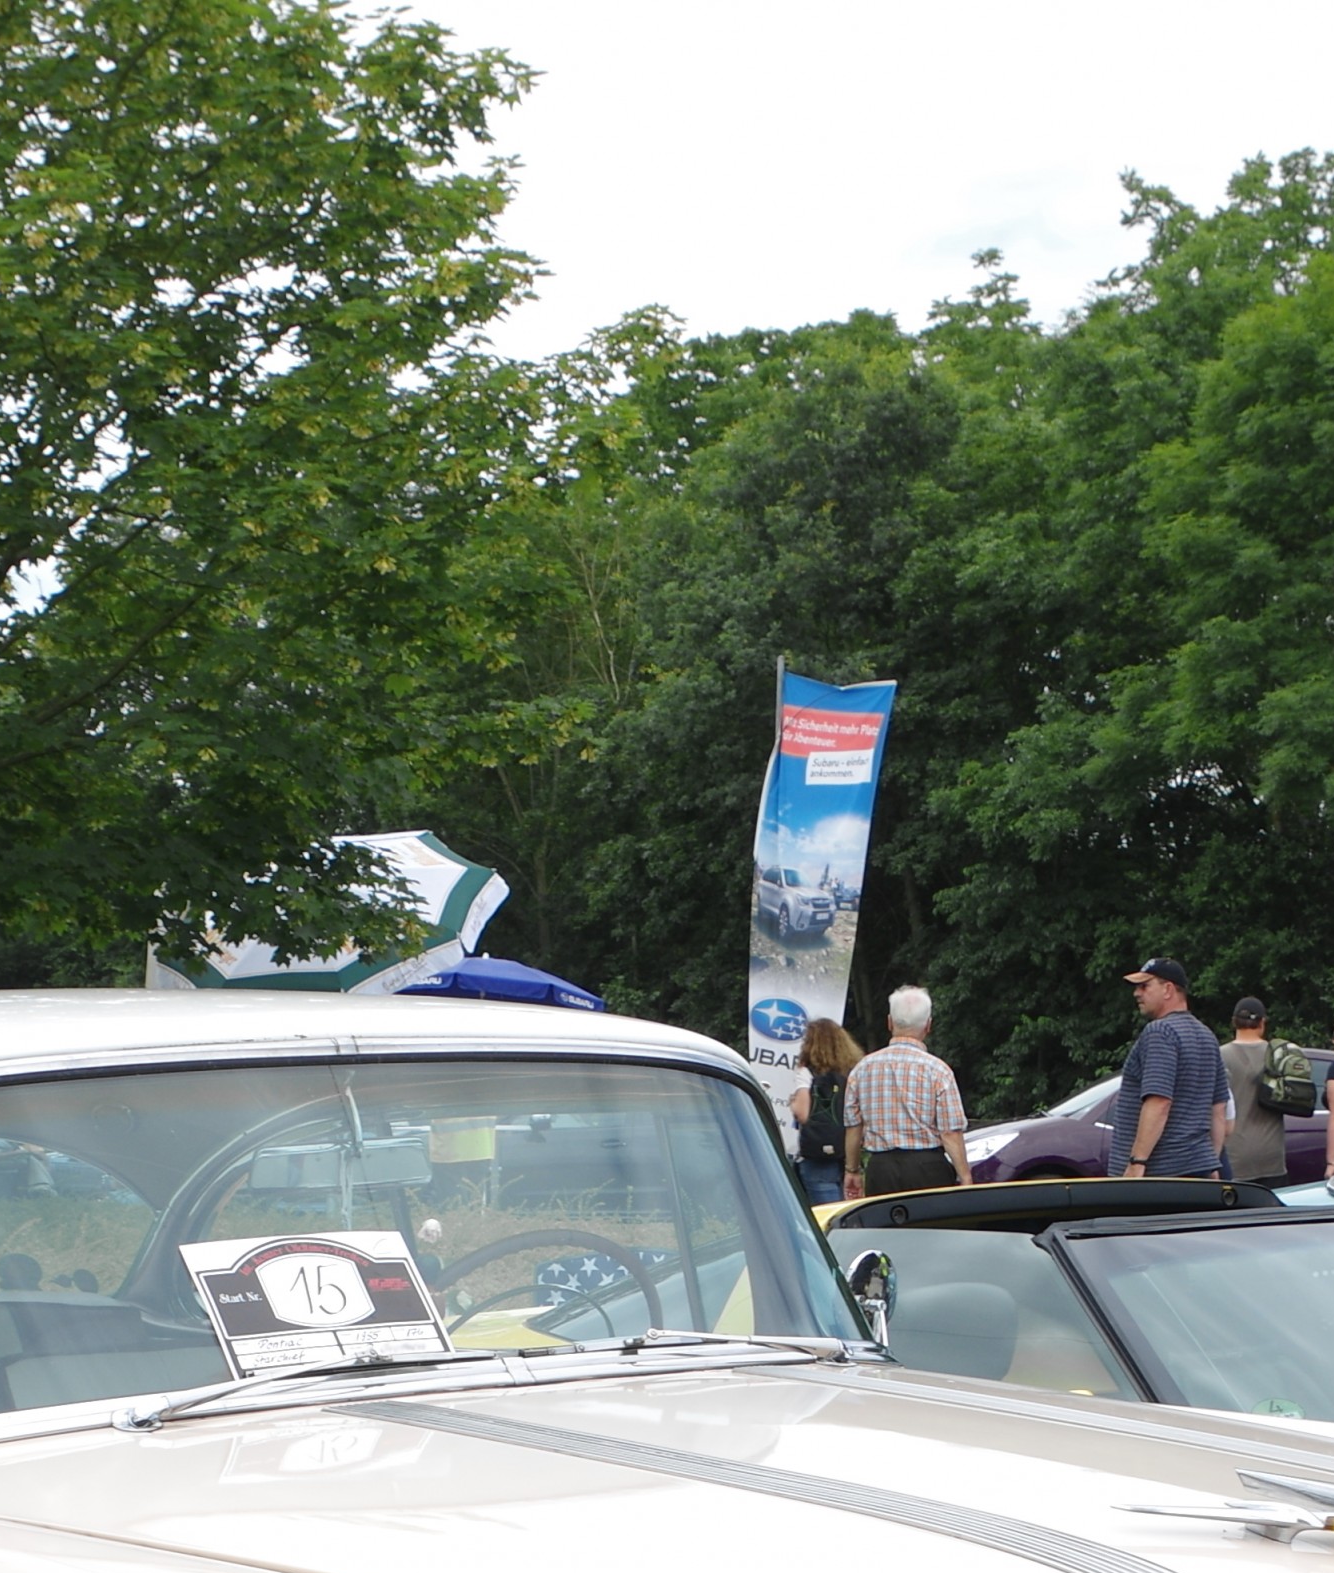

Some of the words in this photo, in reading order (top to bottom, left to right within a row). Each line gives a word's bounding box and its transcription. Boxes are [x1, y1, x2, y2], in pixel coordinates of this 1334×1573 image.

[289, 1263, 348, 1316] 15
[218, 1292, 245, 1305] Start
[245, 1290, 263, 1302] Nr.
[257, 1337, 303, 1350] Pontiac
